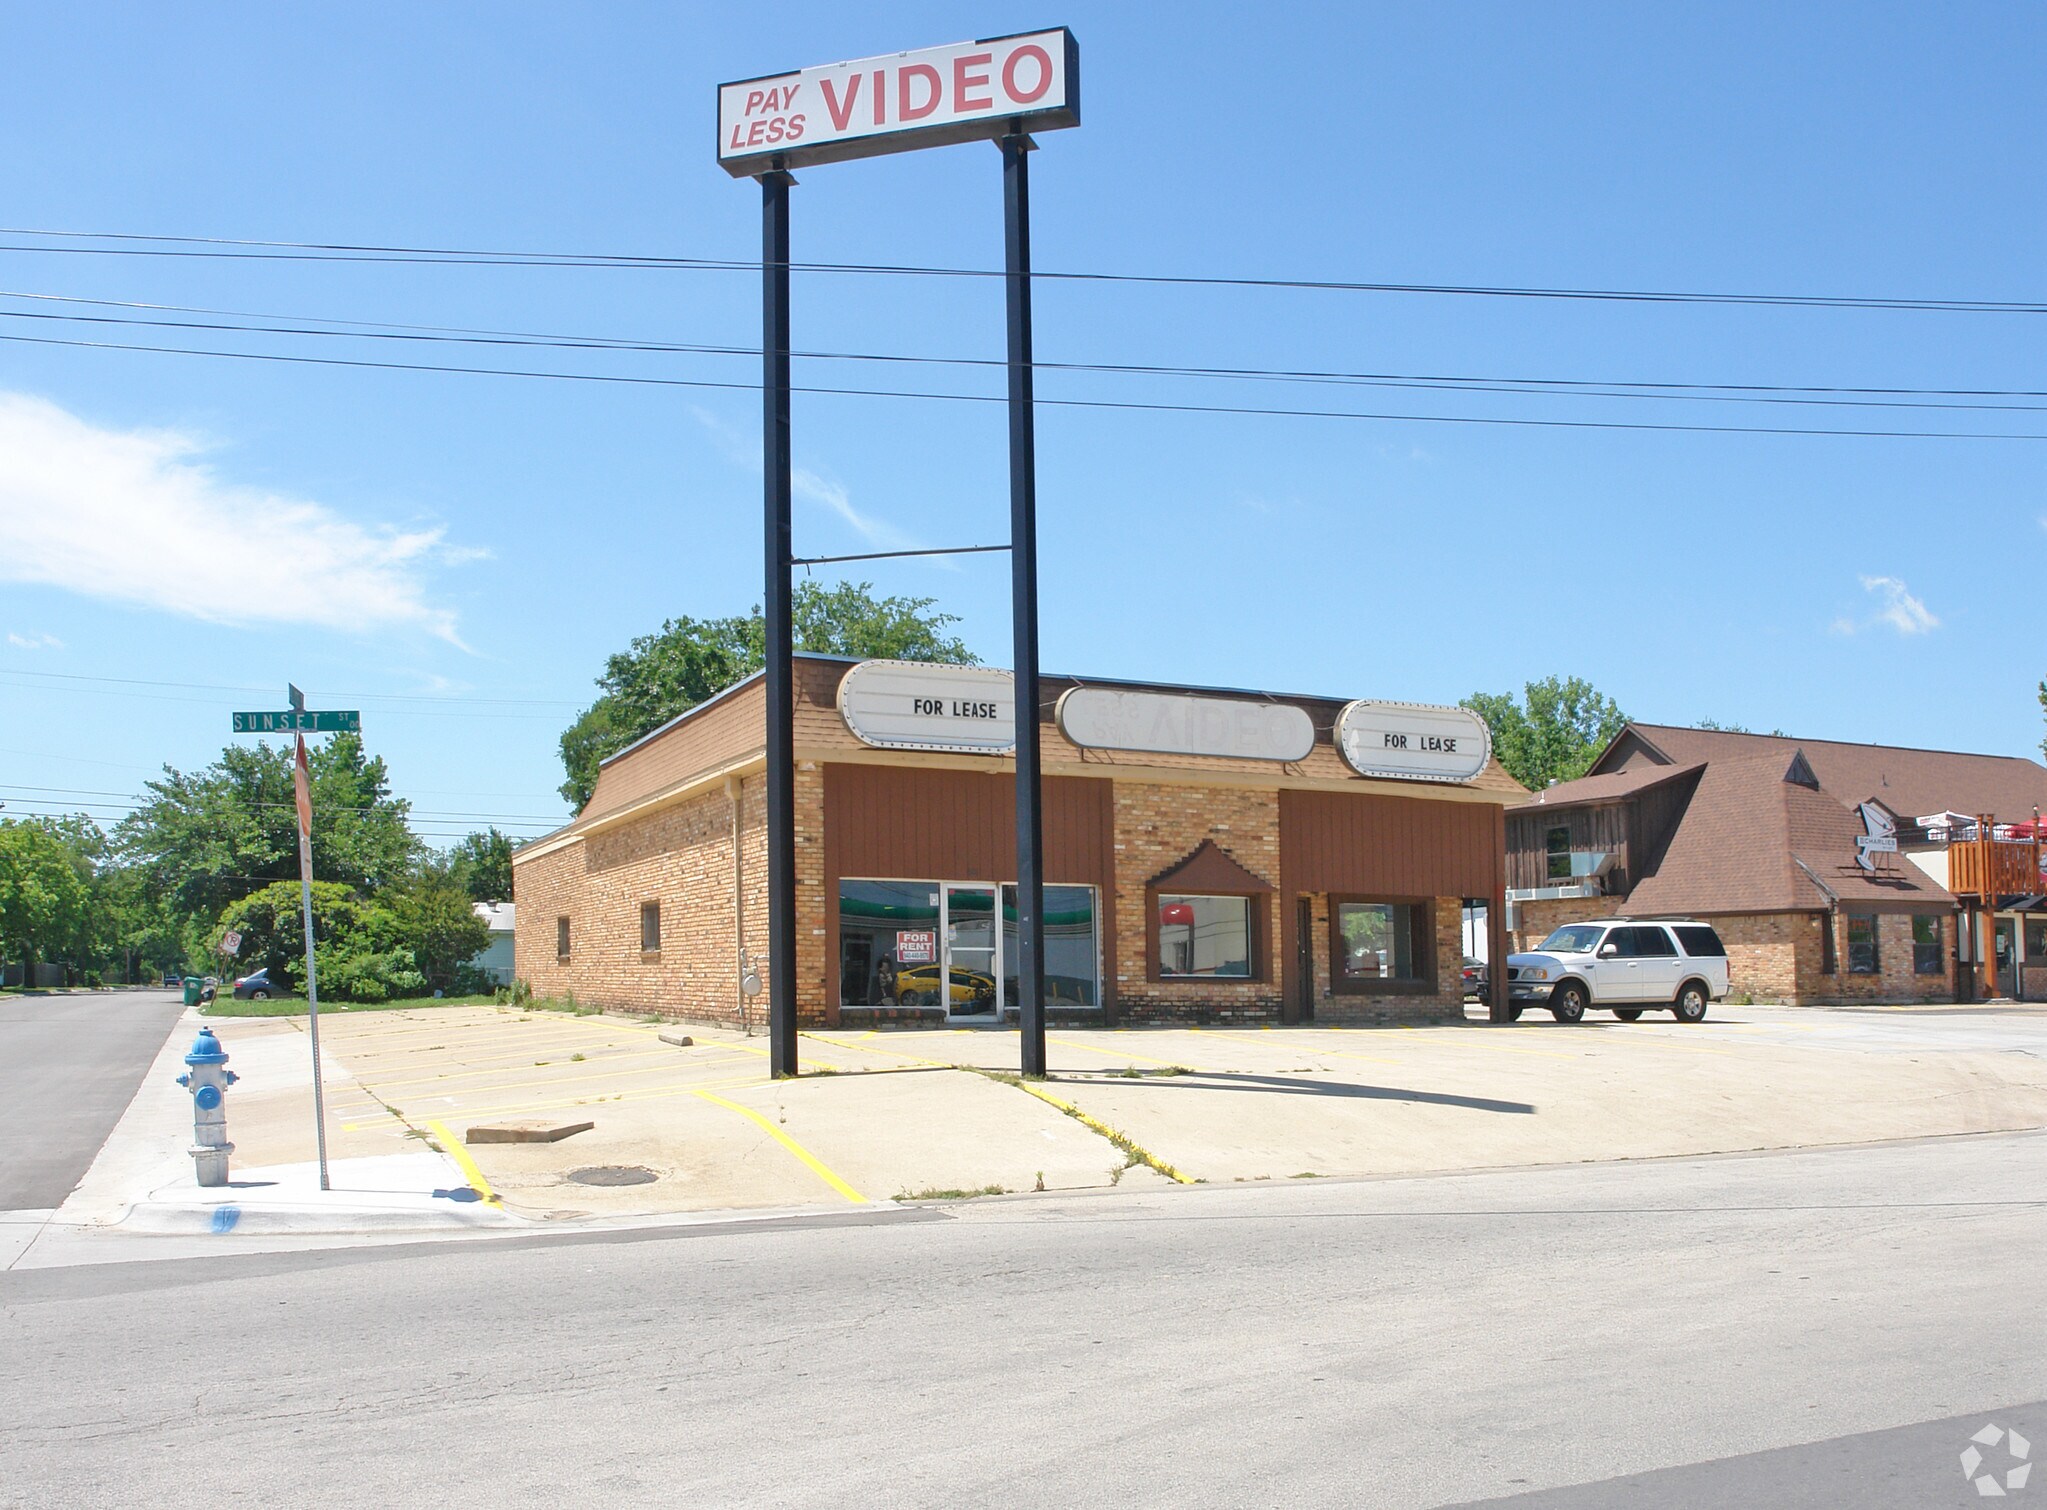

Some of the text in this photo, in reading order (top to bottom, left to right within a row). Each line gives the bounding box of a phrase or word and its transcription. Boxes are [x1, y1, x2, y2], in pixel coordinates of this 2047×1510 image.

[819, 44, 1053, 131] VIDEO
[744, 83, 801, 117] PAY
[729, 114, 806, 150] LESS
[914, 698, 997, 719] FOR LEASE
[234, 712, 349, 730] SUNSET ST
[1384, 733, 1456, 753] FOR LEASE
[900, 942, 932, 951] RENT
[903, 933, 928, 942] FOR
